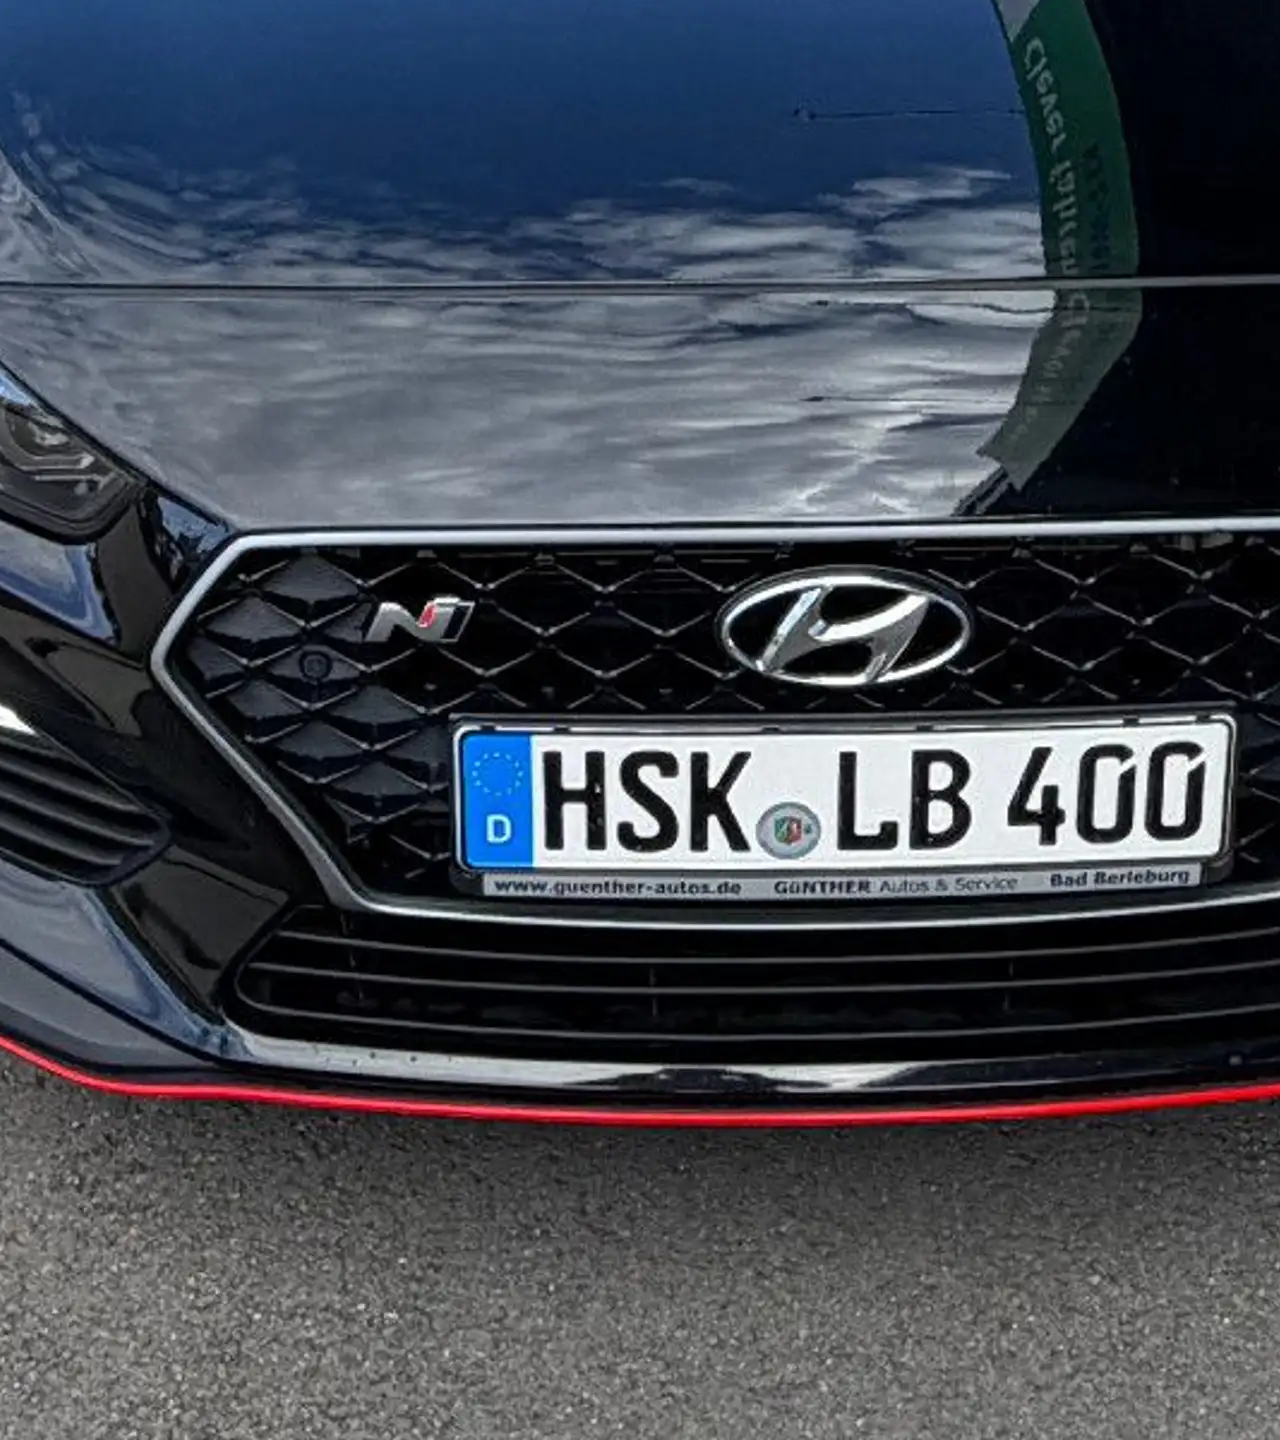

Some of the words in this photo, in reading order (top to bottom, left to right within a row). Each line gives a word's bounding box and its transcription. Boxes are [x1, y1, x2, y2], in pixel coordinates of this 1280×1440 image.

[542, 750, 753, 853] HSK
[836, 748, 972, 851] LB
[1006, 740, 1206, 846] 400
[486, 814, 512, 844] D
[494, 877, 742, 897] www.guenther-autos.de
[879, 876, 930, 894] Autos
[934, 876, 949, 893] &
[954, 874, 1019, 893] Service
[1050, 872, 1088, 888] Bad
[1093, 869, 1191, 889] Berleburg
